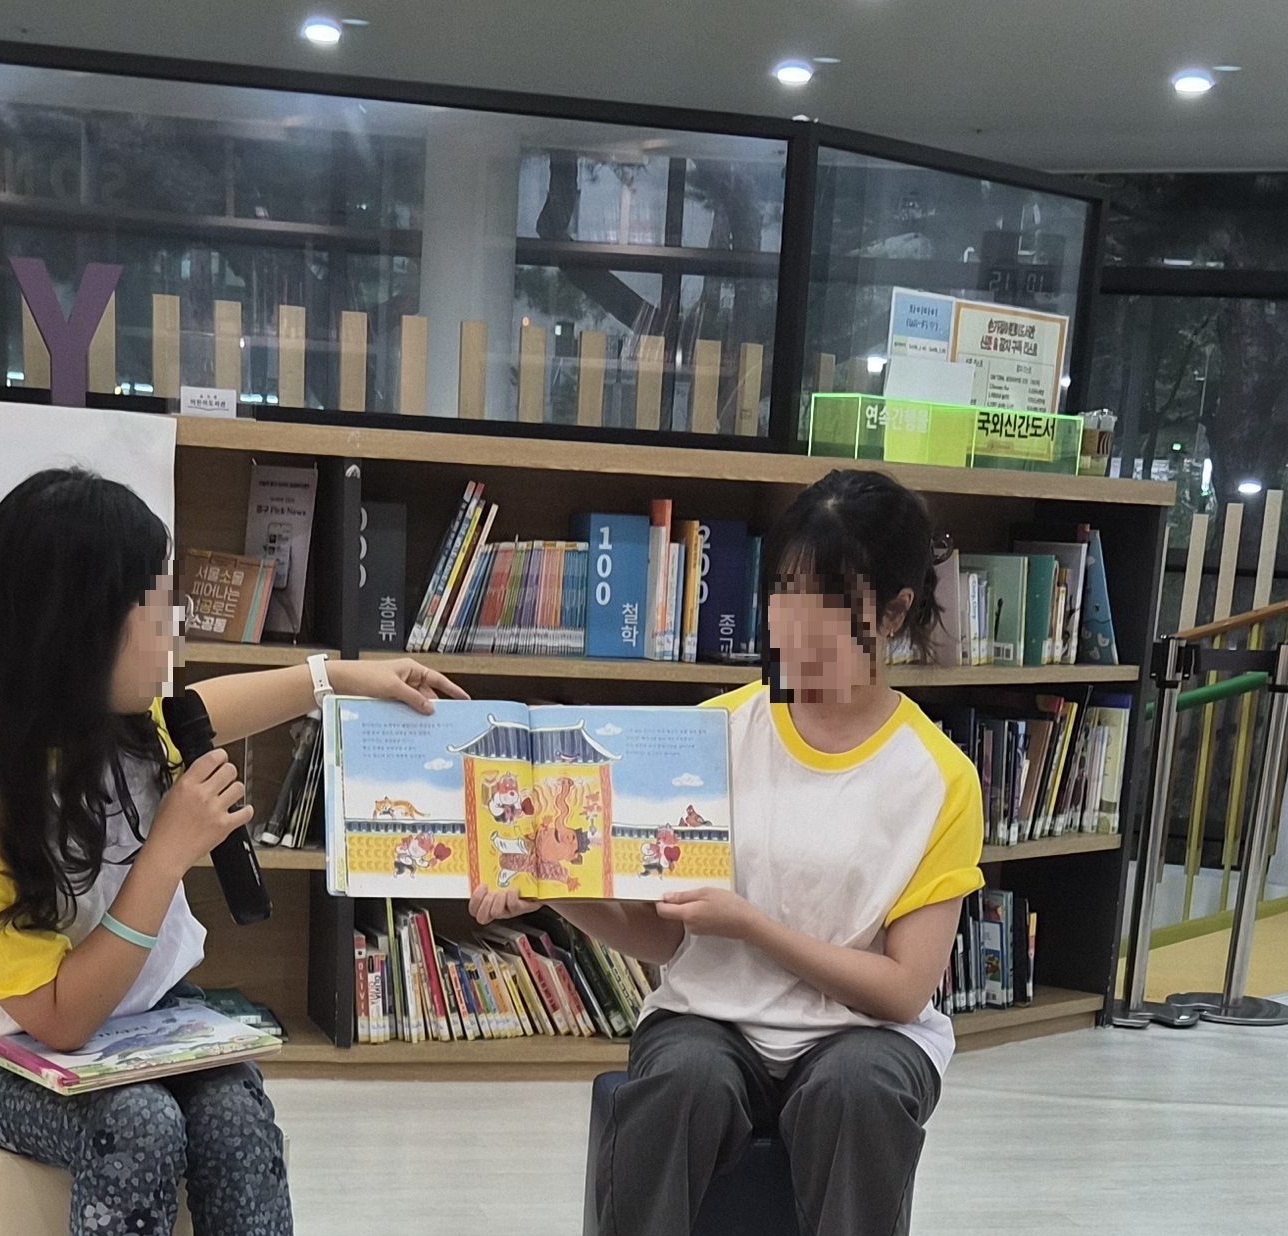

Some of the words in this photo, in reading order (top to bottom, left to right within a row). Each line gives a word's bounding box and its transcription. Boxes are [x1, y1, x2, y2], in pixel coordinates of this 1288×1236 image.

[977, 411, 1056, 441] 국외신간도서
[595, 526, 613, 606] 100
[191, 581, 240, 603] 피어나는
[378, 595, 398, 642] 총류
[621, 603, 638, 647] 철학
